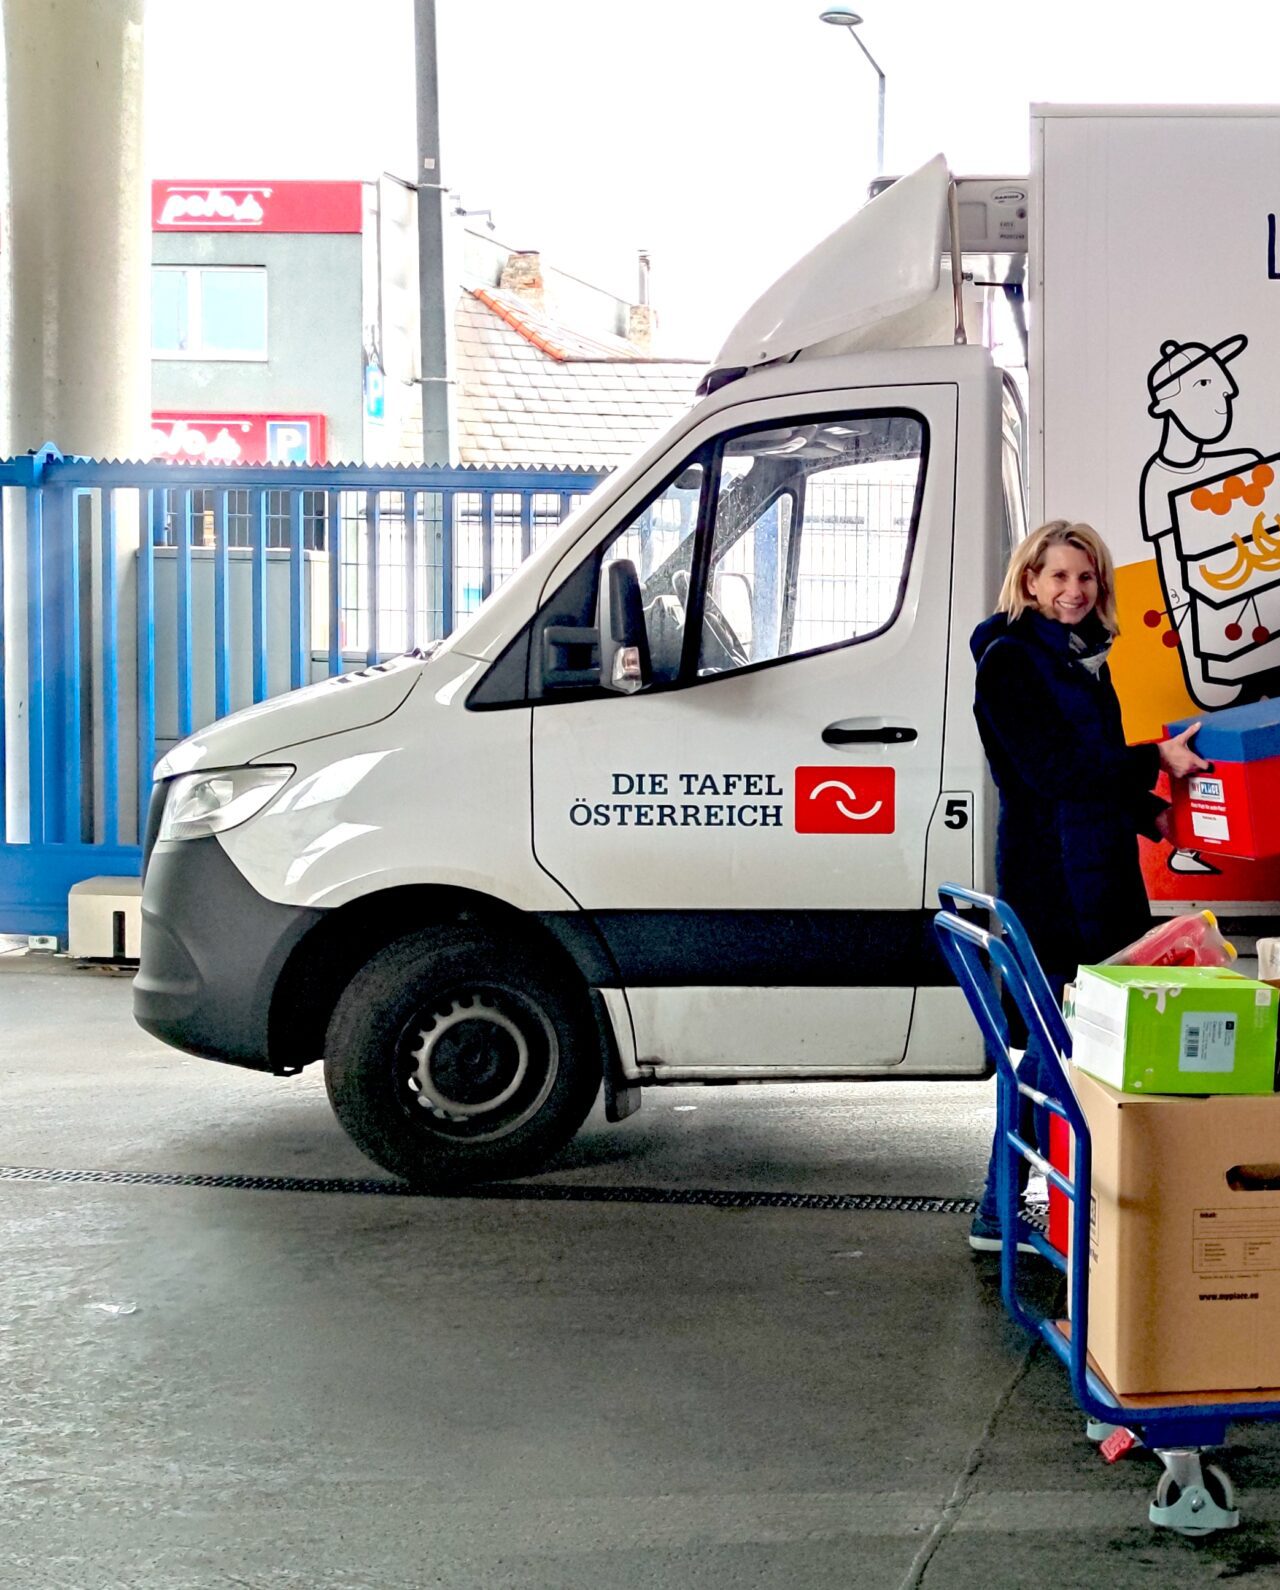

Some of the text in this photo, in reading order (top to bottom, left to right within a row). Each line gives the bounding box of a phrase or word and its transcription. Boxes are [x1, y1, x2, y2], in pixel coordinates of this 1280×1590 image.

[276, 428, 302, 464] P
[611, 773, 783, 796] DIE TAFEL
[568, 798, 783, 827] ÖSTERREICH
[944, 800, 969, 830] 5
